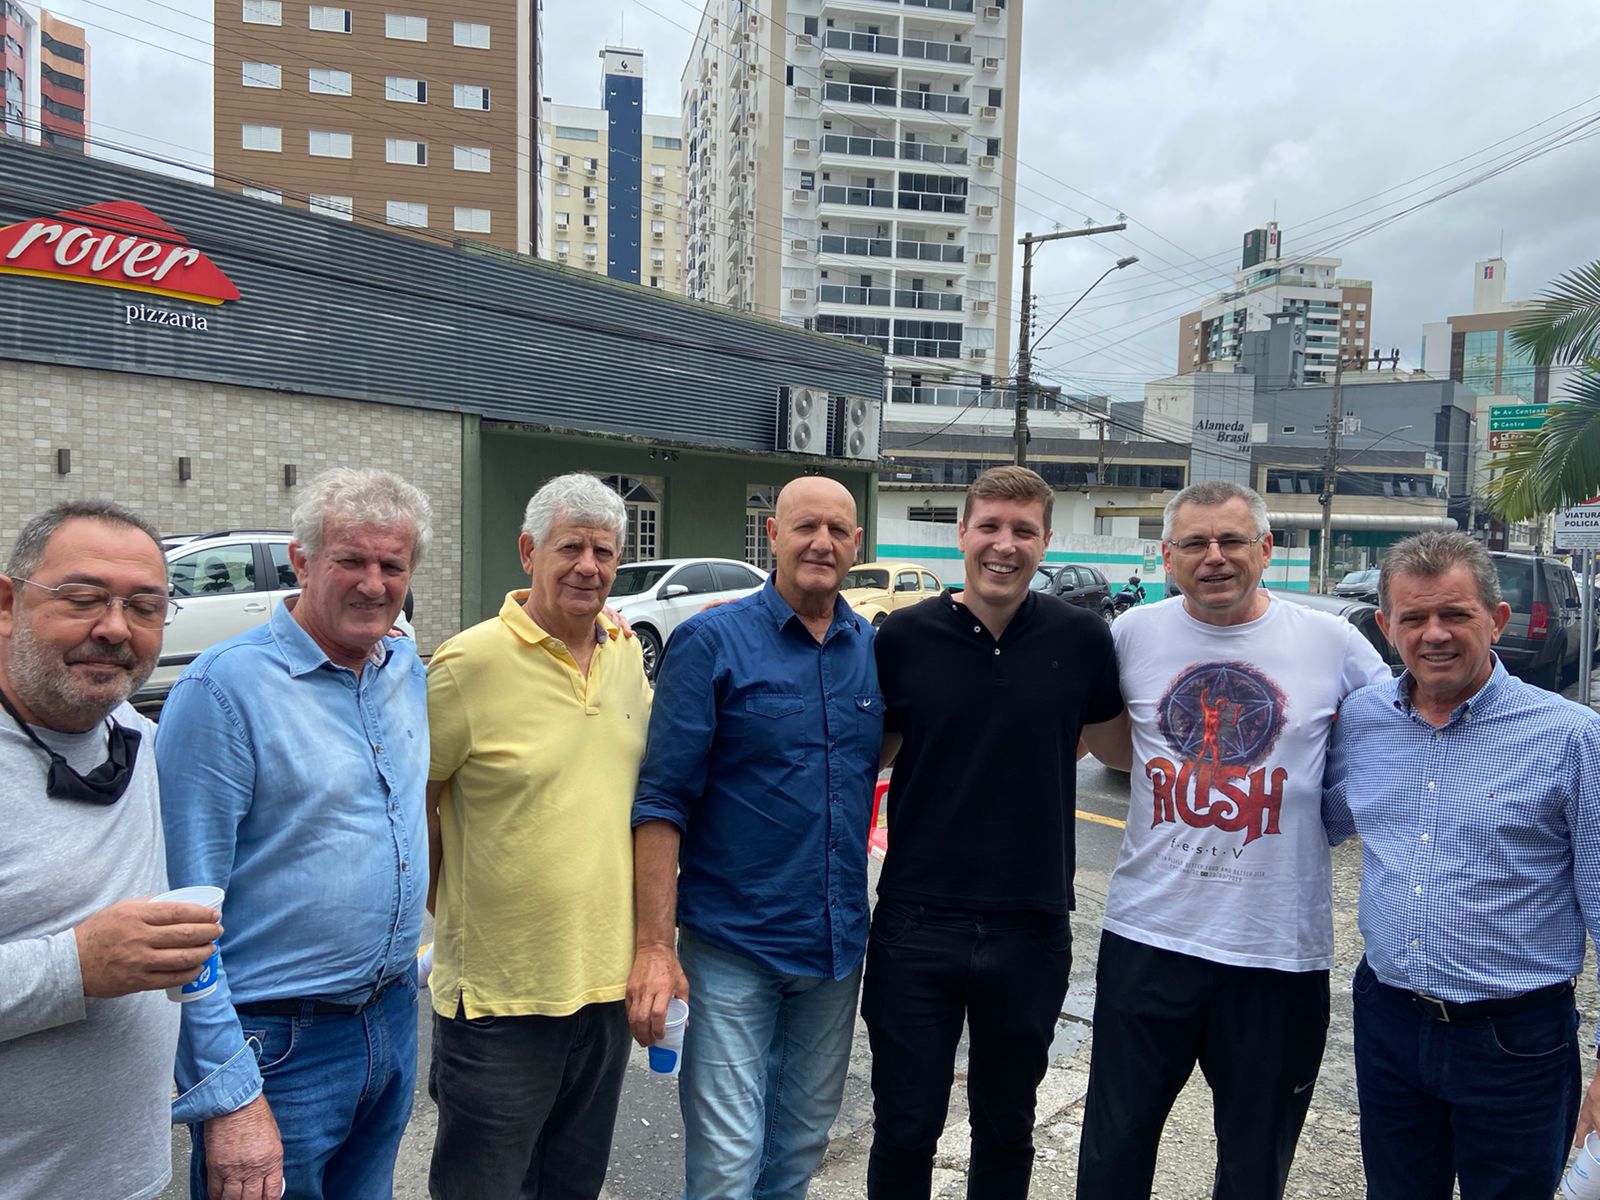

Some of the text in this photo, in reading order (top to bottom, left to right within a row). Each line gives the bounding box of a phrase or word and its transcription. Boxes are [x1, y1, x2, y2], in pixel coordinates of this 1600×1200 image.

[6, 222, 200, 281] rover
[125, 303, 208, 331] pizzaria
[1195, 419, 1245, 431] Alameda
[1216, 431, 1250, 443] Brasil
[1145, 756, 1288, 847] RUSH
